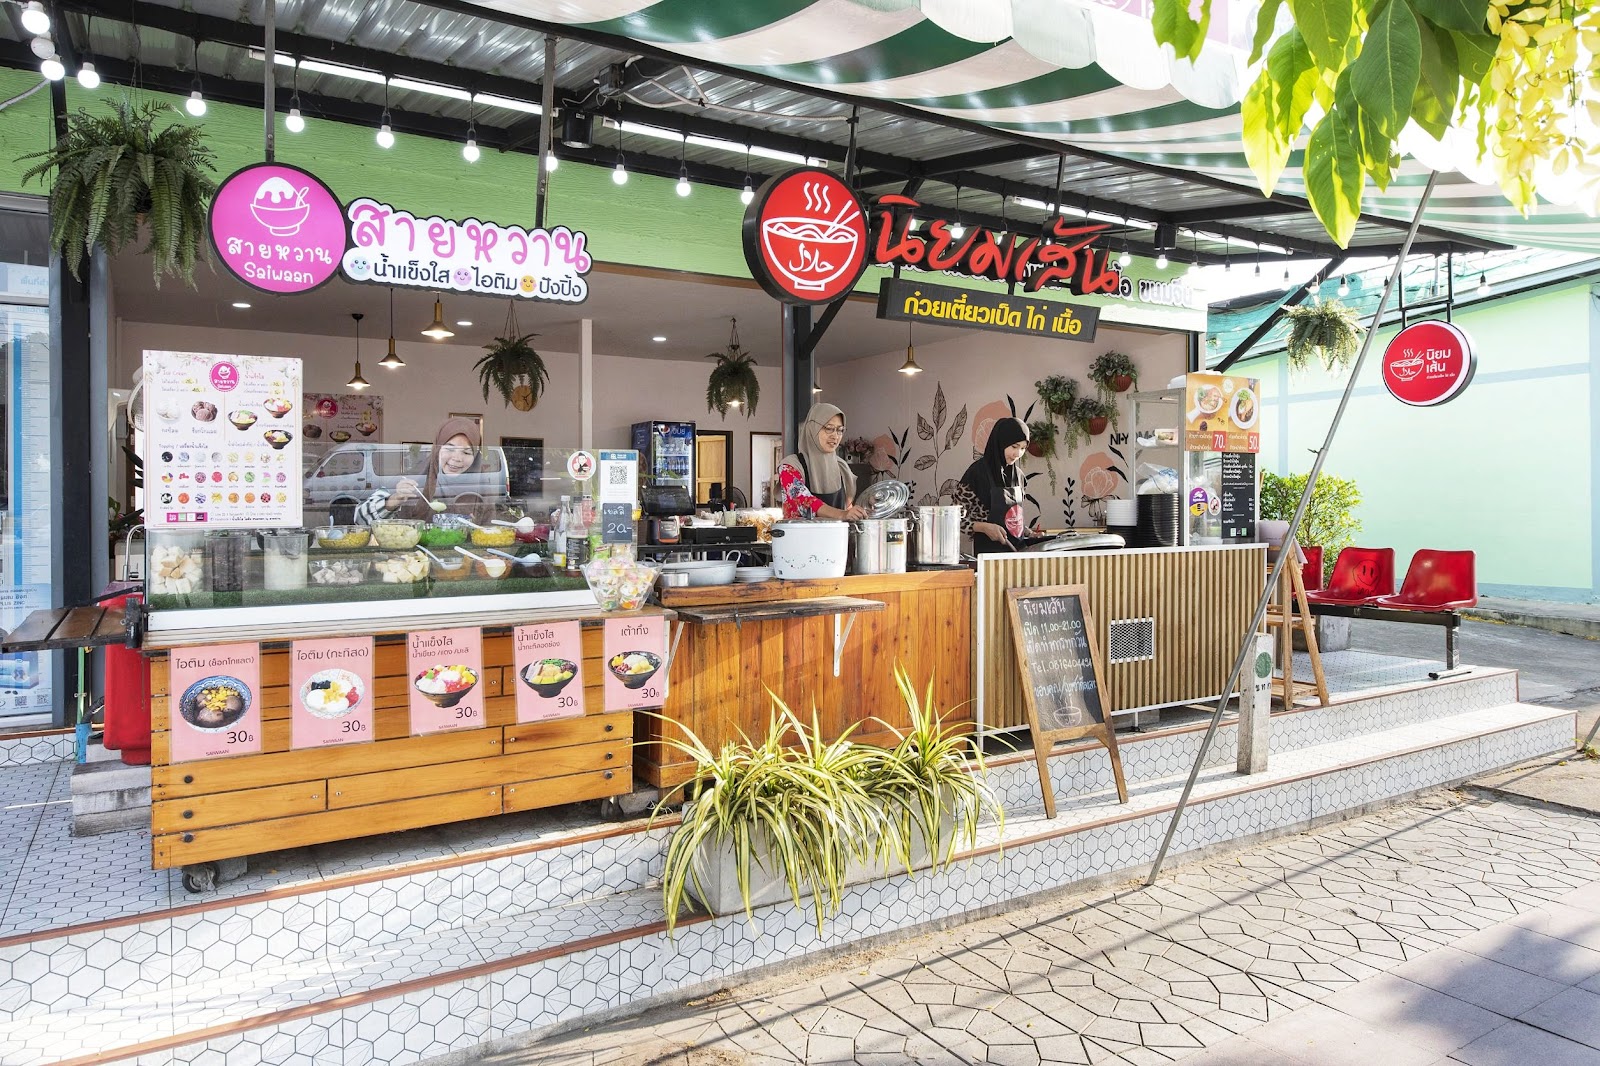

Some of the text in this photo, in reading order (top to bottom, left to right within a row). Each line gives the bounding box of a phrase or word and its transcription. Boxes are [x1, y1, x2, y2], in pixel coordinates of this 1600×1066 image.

[353, 204, 589, 272] สายหวาน
[875, 194, 1119, 294] นิยมเส้น
[226, 237, 332, 264] สายหวาน
[789, 242, 835, 273] حلال
[244, 262, 313, 284] Saiwaan
[374, 253, 582, 297] น้ำแข็งใส ไอติม ปังปิ้ง
[903, 291, 1082, 335] ก๋วยเตี๋ยวเป็ด ไก่ เนื้อ
[1426, 348, 1451, 361] นิยม
[1426, 360, 1446, 373] เส้น
[1023, 597, 1066, 616] นิยมเส้น
[412, 635, 453, 649] น้ำแข็งใส
[517, 629, 554, 642] น้ำแข็งใส
[175, 657, 205, 669] ไอติม
[297, 647, 369, 660] ไอติม (กะทิสด)
